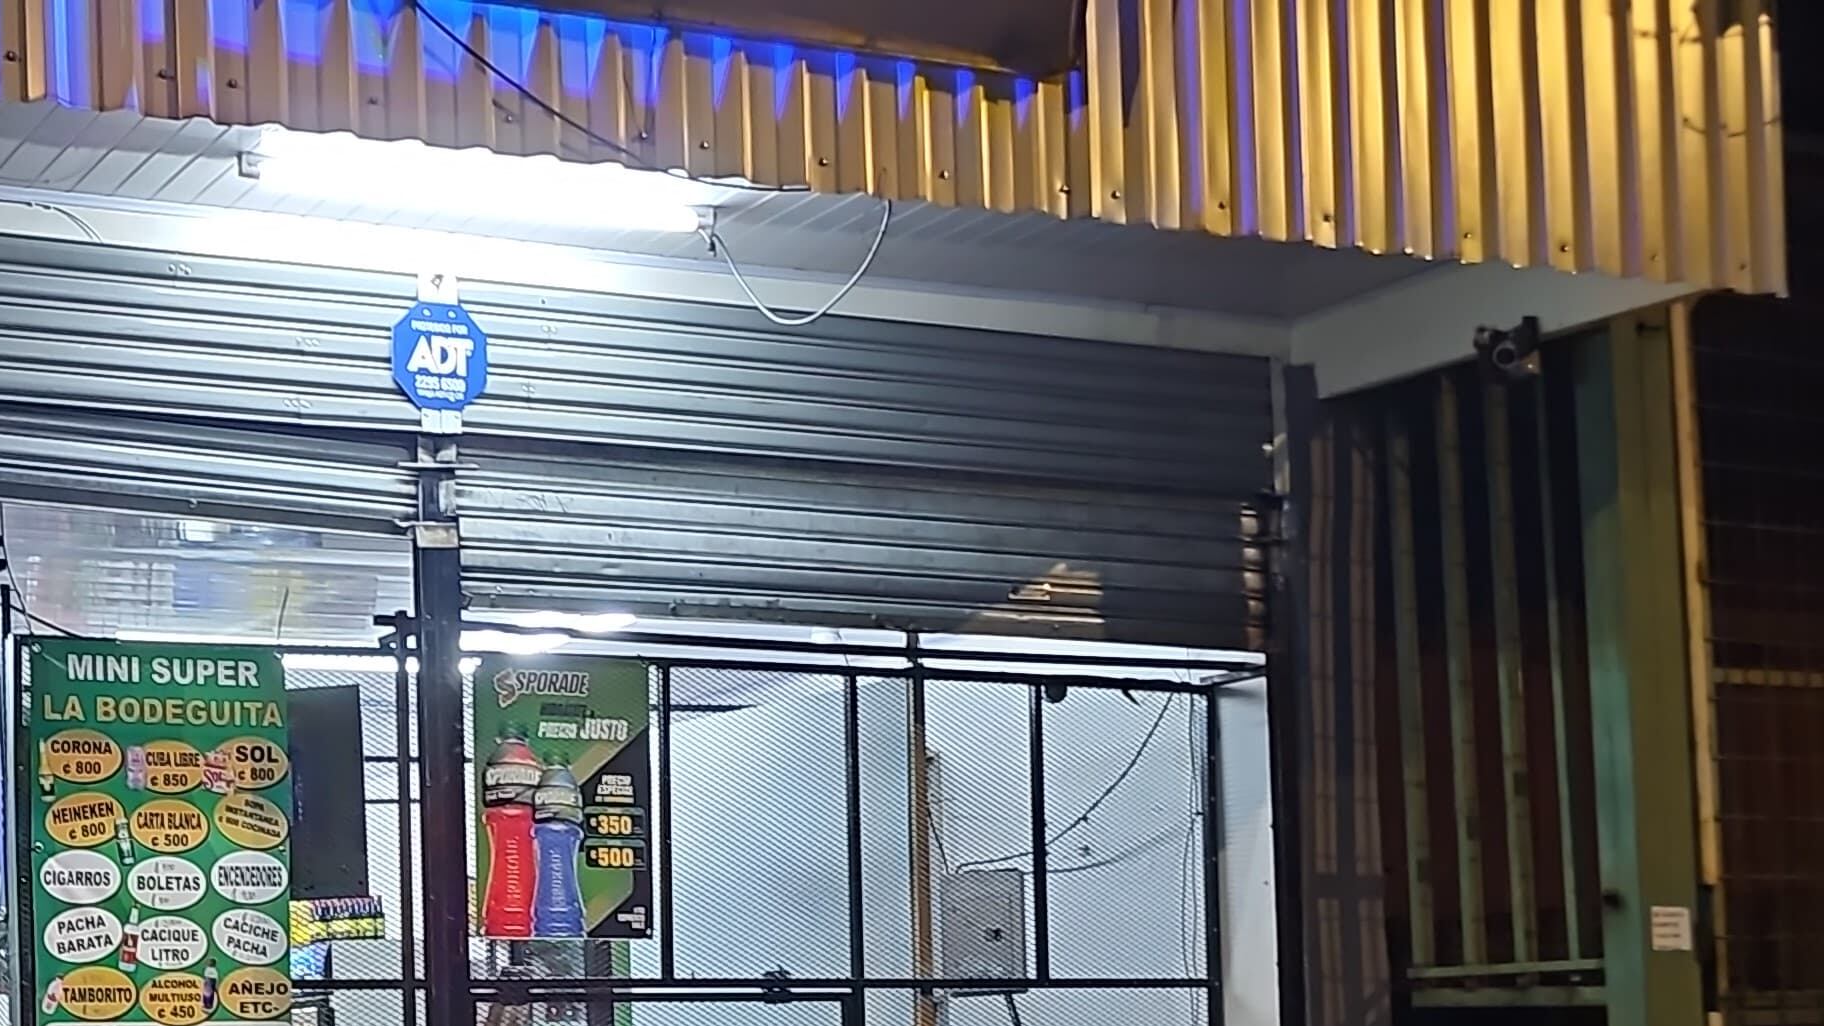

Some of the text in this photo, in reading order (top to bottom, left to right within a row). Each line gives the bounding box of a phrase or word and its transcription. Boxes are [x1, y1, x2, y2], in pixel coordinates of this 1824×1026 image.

[406, 334, 474, 377] ADT
[67, 653, 259, 687] MINI SUPER
[516, 672, 589, 695] SPORADE
[43, 695, 284, 727] LA BODEGUITA
[580, 717, 629, 741] JUSTO
[50, 740, 112, 755] CORONA
[235, 745, 279, 764] SOL
[76, 761, 102, 775] 800
[146, 751, 201, 768] CUBA LIBRE
[163, 773, 188, 787] 850
[250, 767, 275, 781] 800
[52, 802, 115, 825] HEINEKEN
[136, 811, 202, 830] CARTA BLANCA
[81, 822, 106, 838] 800
[163, 834, 189, 847] 500
[43, 870, 111, 887] CIGARROS
[136, 876, 201, 892] BOLETAS
[57, 915, 106, 935] PACHA
[223, 917, 280, 942] CACICHE
[56, 934, 114, 955] BARATA
[141, 928, 200, 944] CACIQUE
[151, 948, 190, 962] LITRO
[226, 936, 268, 958] PACHA
[151, 980, 199, 990] ALCOHOL
[229, 979, 289, 996] AÑEJO
[62, 986, 133, 1004] TAMBORITO
[149, 992, 202, 1003] MULTIUSO
[169, 1005, 196, 1018] 450
